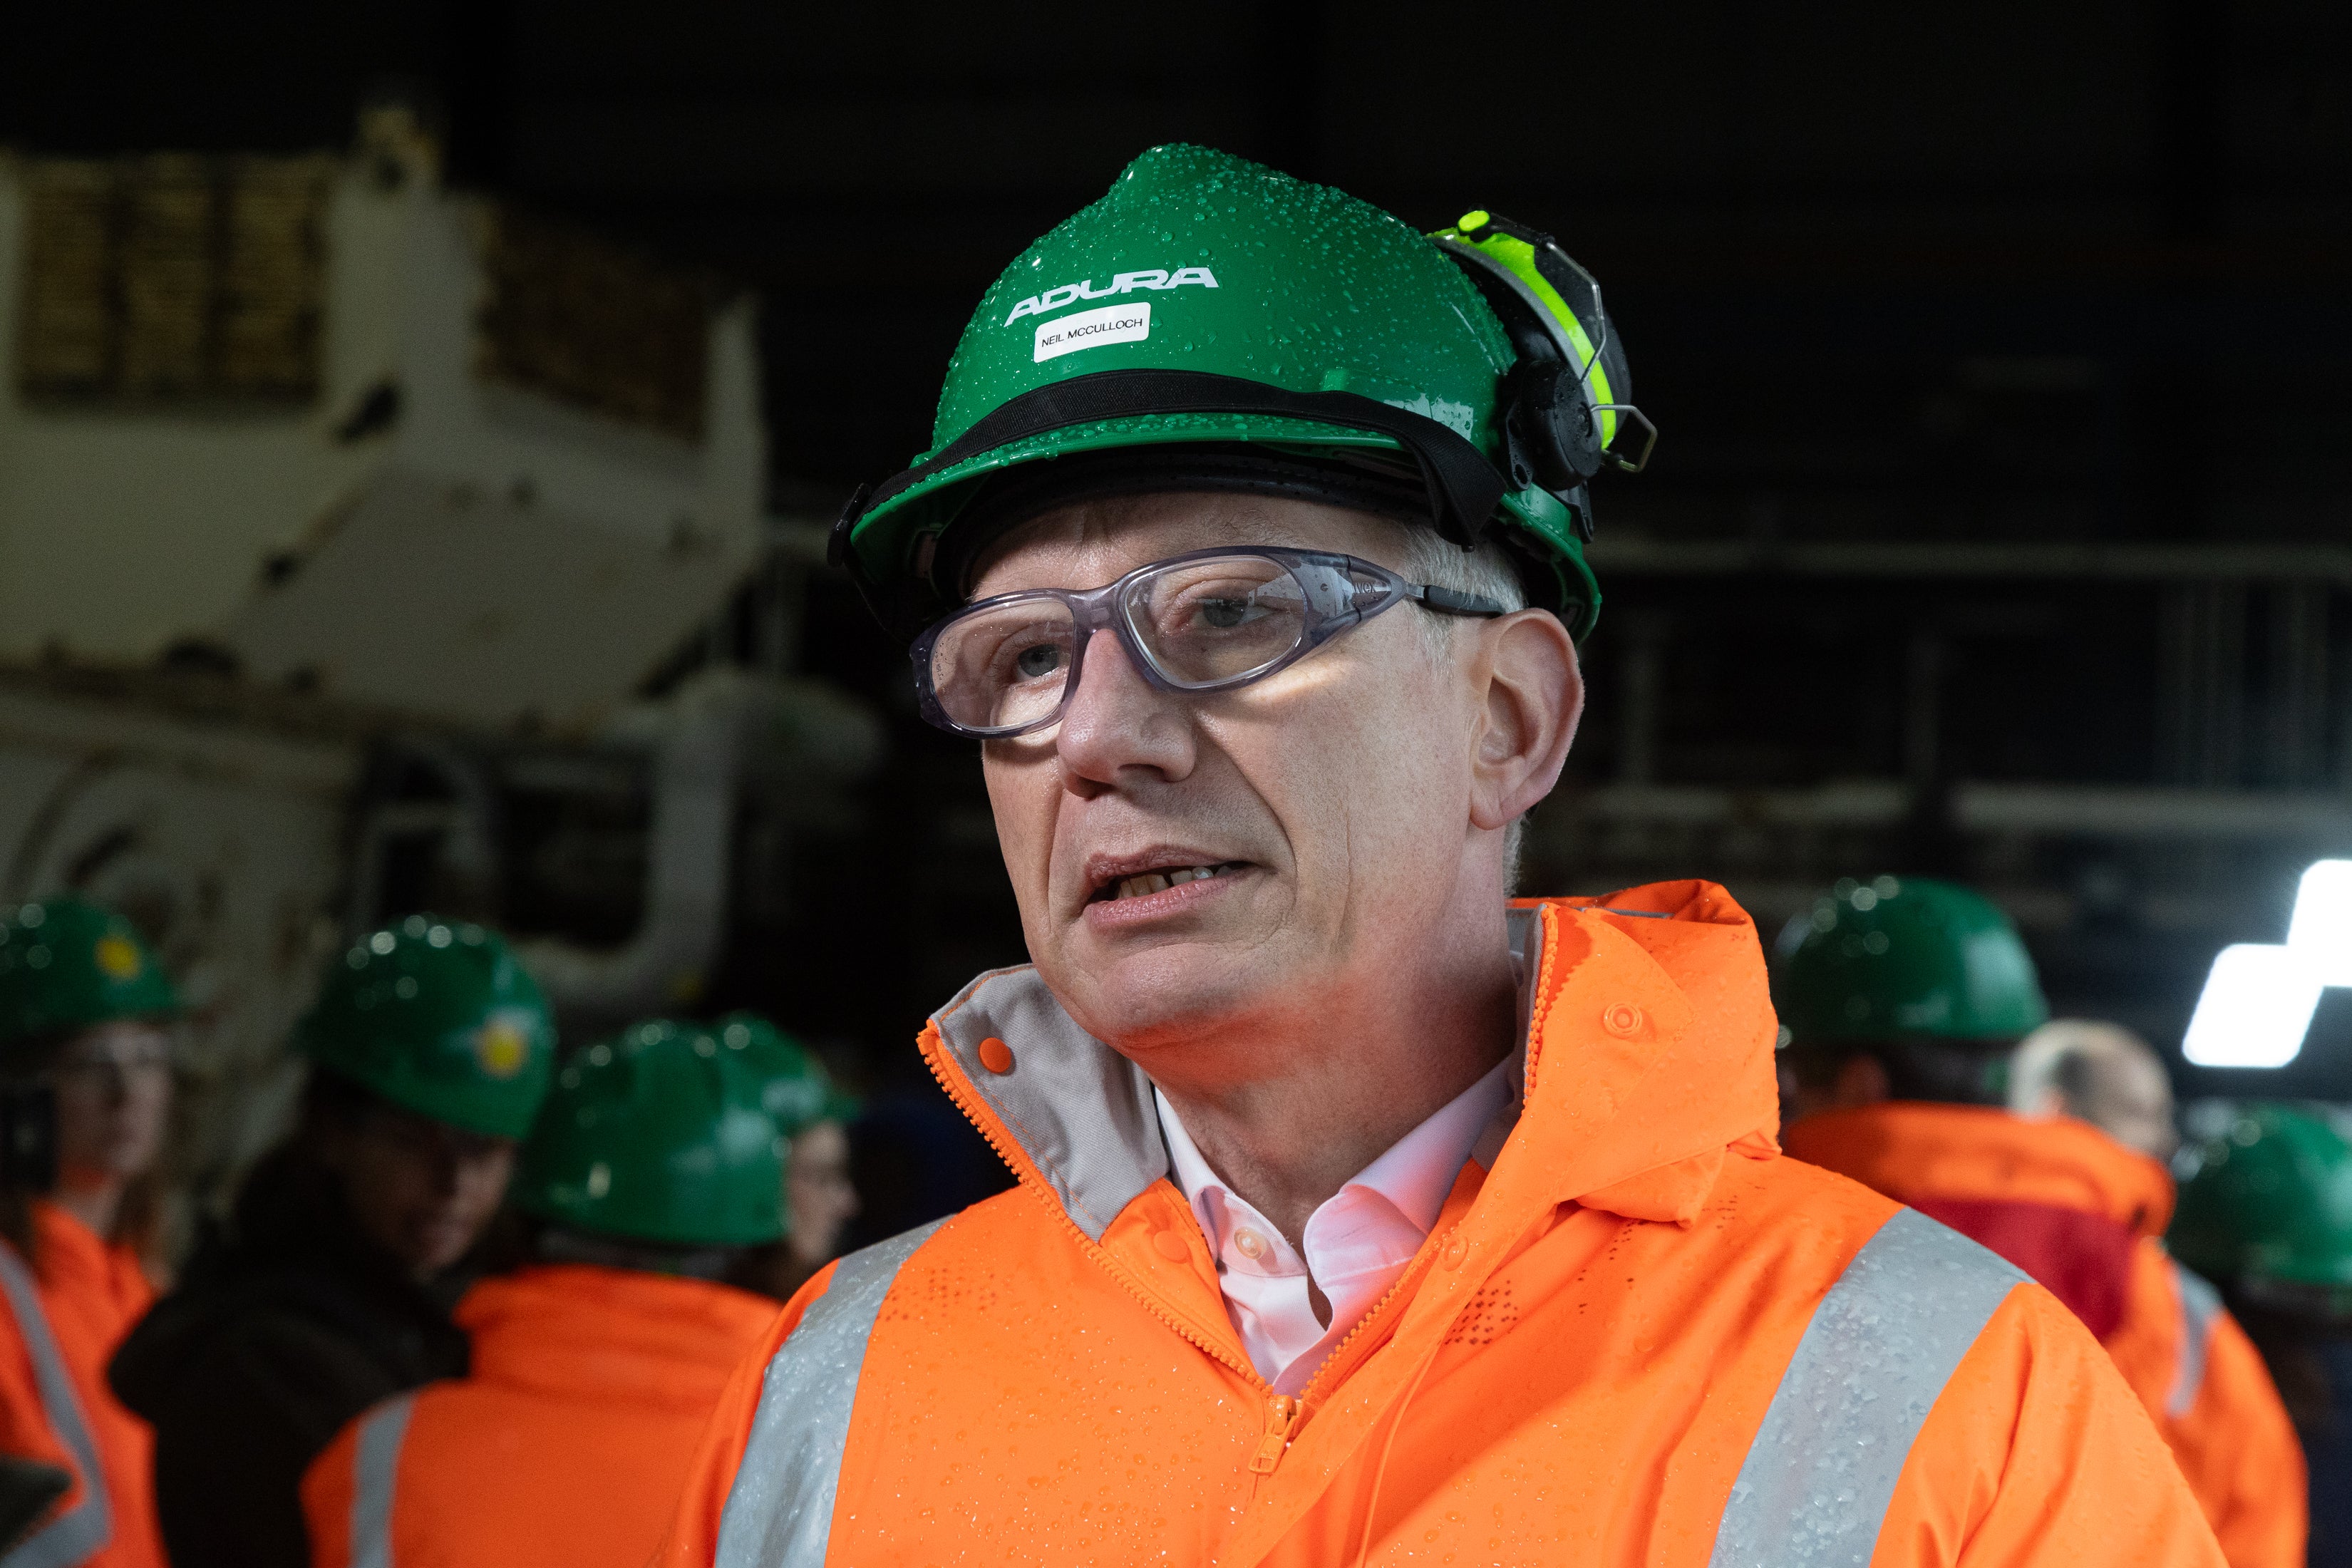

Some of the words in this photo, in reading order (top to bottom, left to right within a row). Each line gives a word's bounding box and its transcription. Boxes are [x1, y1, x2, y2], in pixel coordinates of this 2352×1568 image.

[1004, 267, 1219, 328] ADURA
[1041, 334, 1063, 347] NEIL
[1068, 319, 1143, 339] MCCULLOCH
